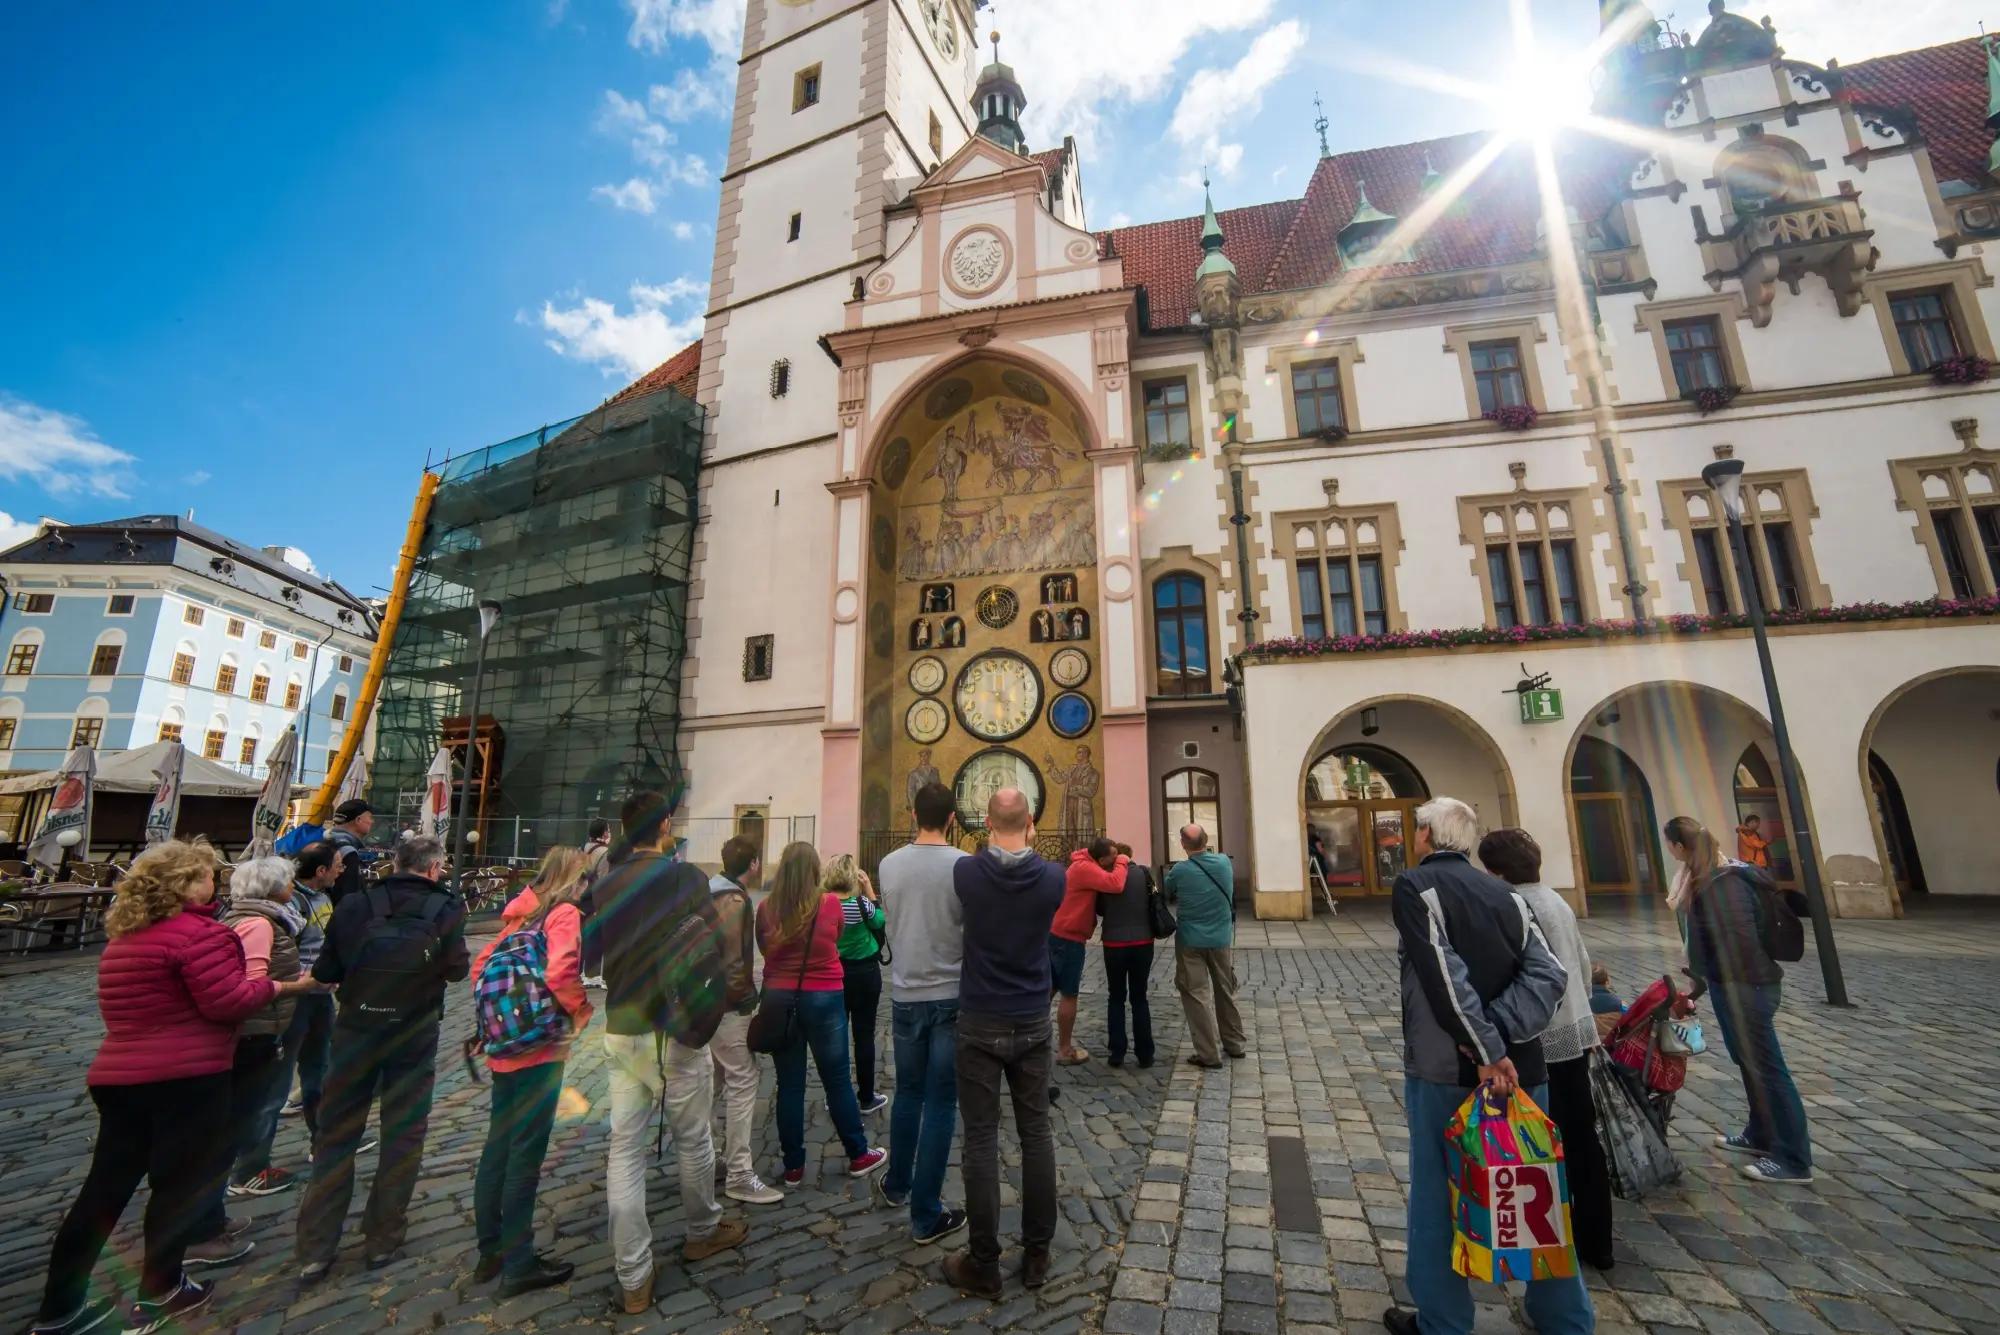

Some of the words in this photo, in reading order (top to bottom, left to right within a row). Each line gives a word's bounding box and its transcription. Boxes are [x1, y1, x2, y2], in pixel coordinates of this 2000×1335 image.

[1539, 692, 1556, 716] i
[1495, 1167, 1518, 1247] RENO
[1515, 1166, 1561, 1246] R
